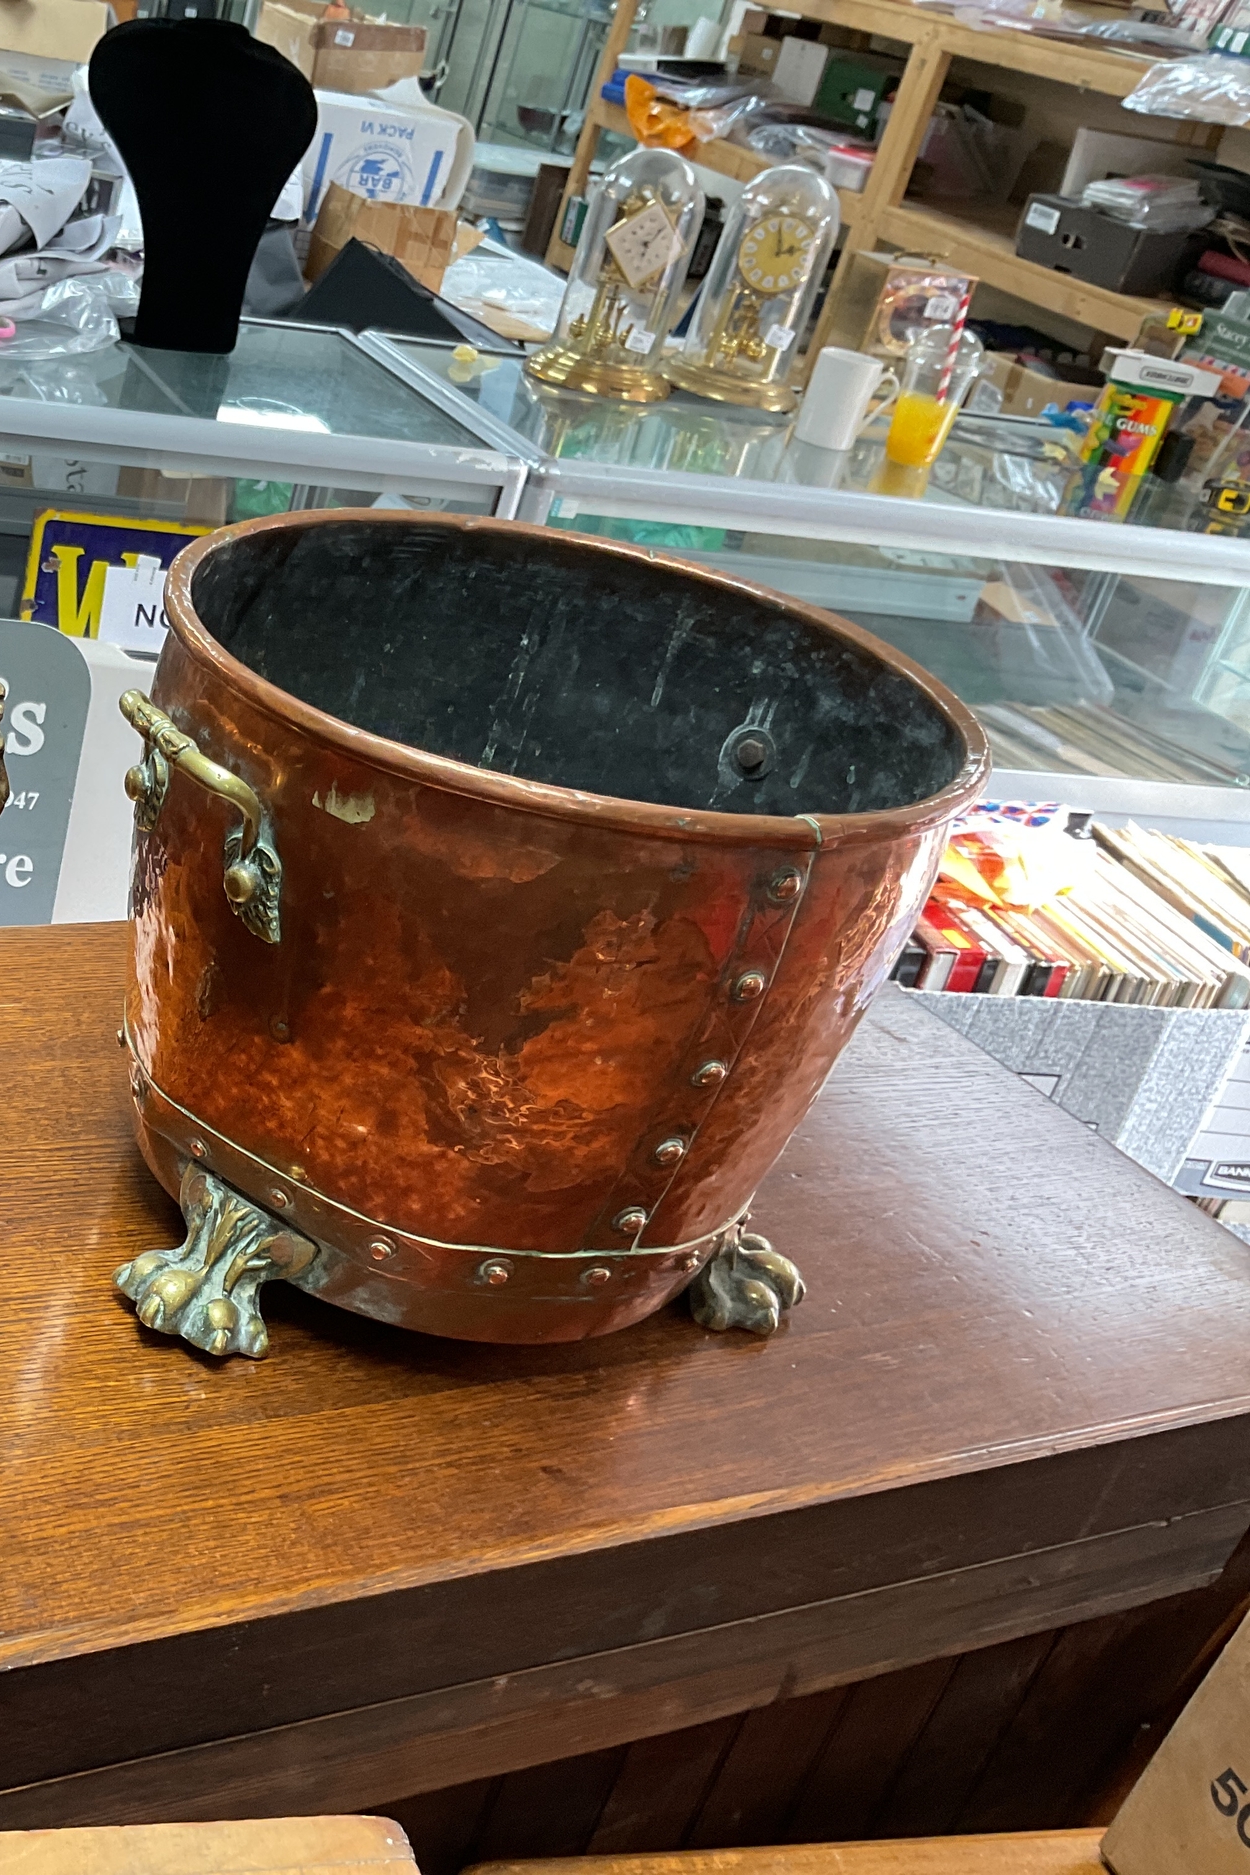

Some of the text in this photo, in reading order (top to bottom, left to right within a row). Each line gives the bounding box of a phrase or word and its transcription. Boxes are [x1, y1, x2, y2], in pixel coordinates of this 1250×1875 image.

[376, 123, 415, 141] PACK
[358, 173, 394, 190] BAR
[1116, 417, 1158, 437] GUMS
